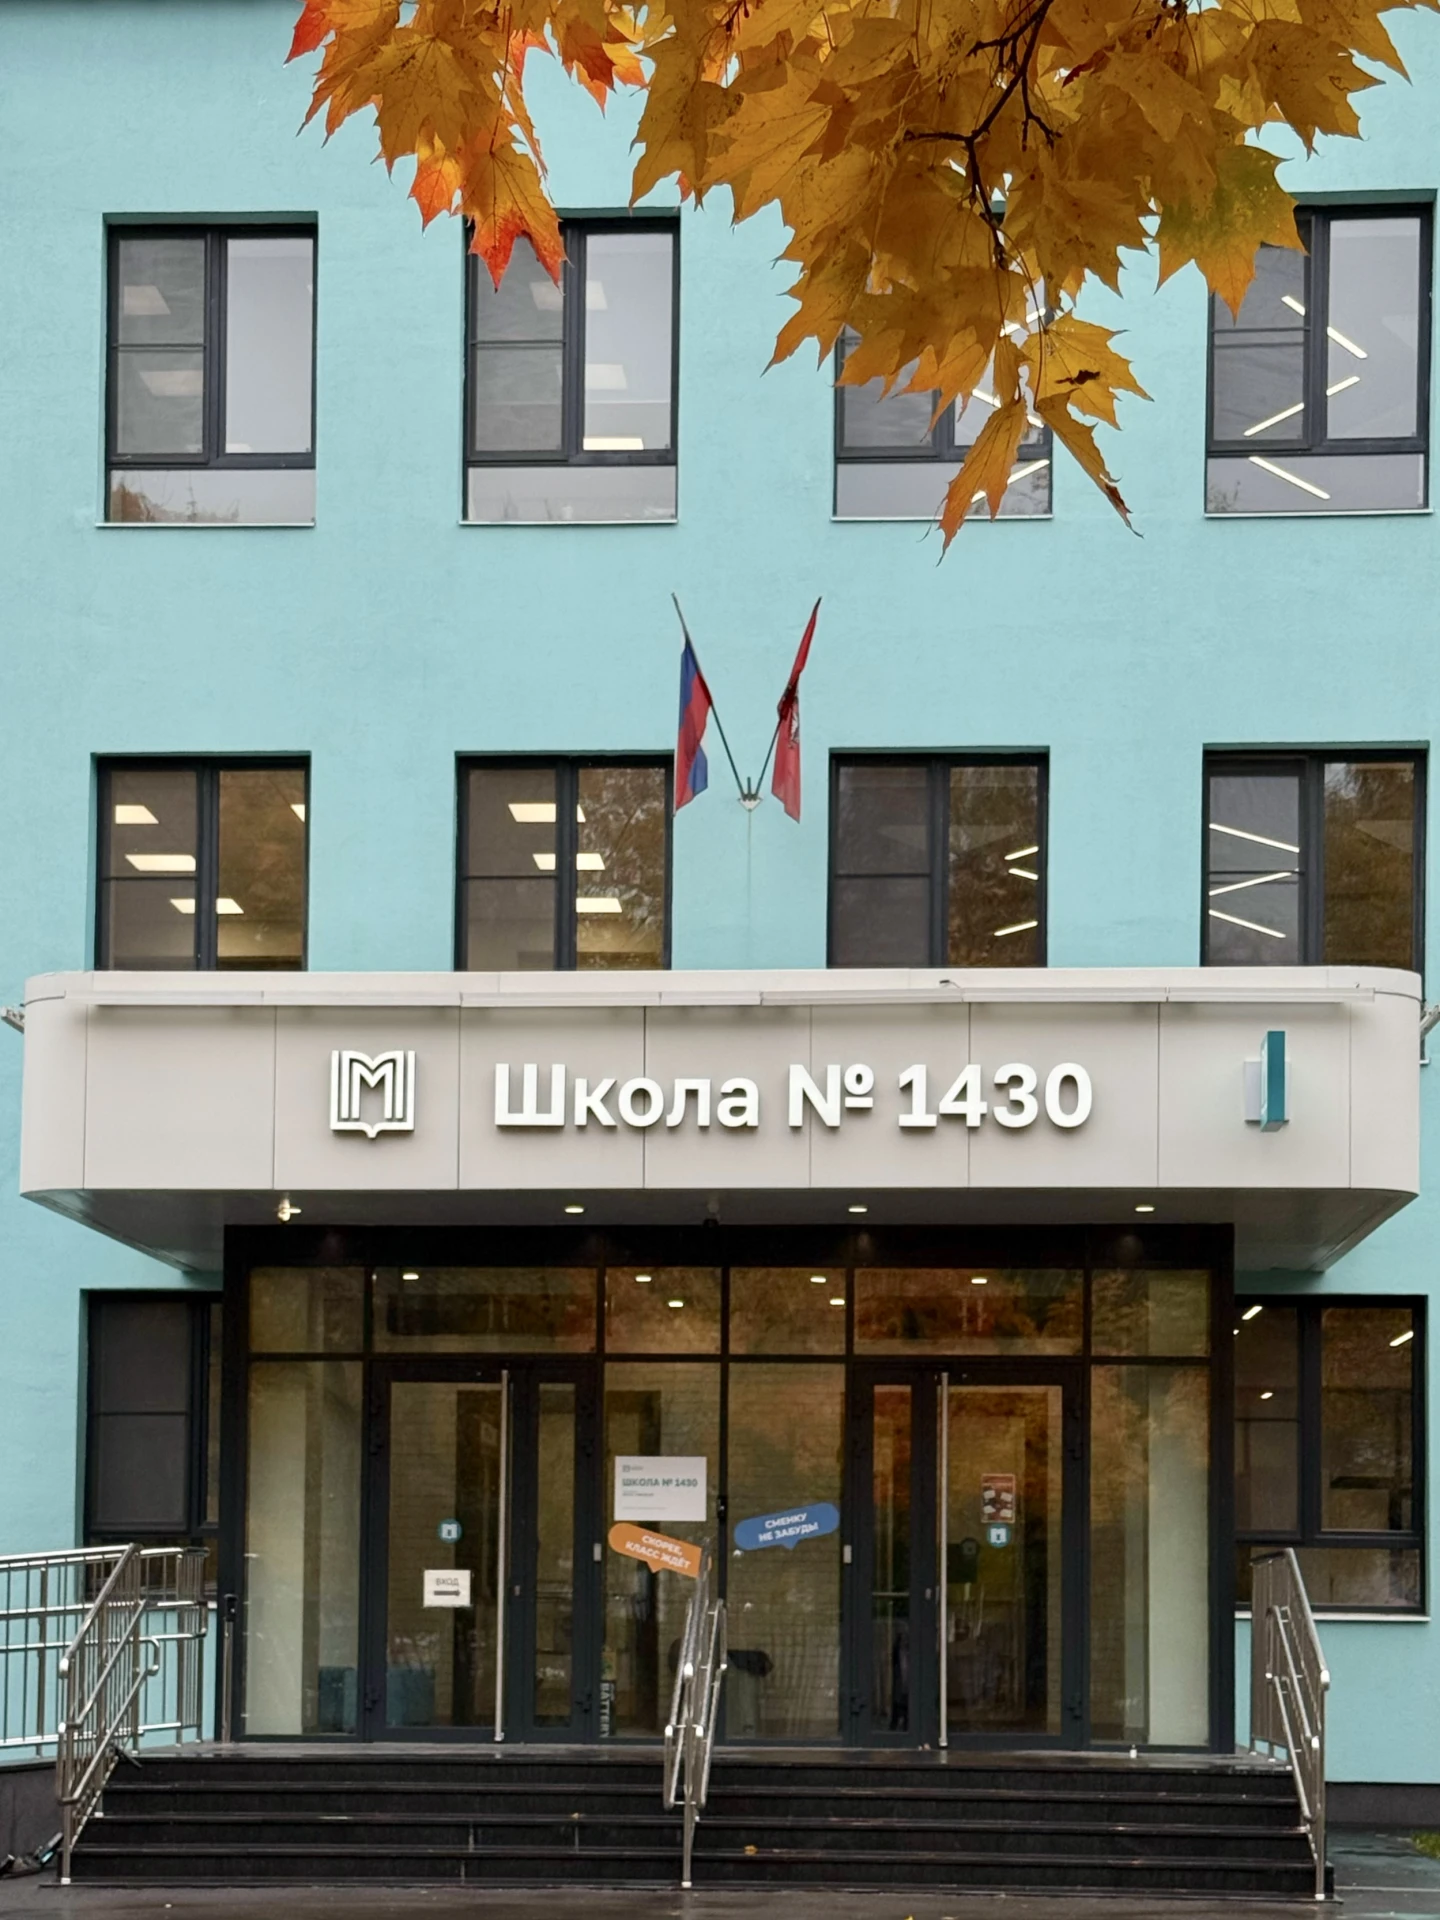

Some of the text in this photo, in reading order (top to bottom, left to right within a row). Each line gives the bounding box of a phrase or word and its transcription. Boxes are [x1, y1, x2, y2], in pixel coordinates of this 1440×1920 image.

[494, 1063, 1093, 1127] Школа № 1430
[622, 1478, 660, 1488] ШКОЛА
[674, 1478, 699, 1488] 1430
[764, 1512, 808, 1529] СМЕНКУ
[758, 1531, 774, 1542] НЕ
[625, 1540, 660, 1559] КЛАСС
[435, 1577, 460, 1586] ВХОД
